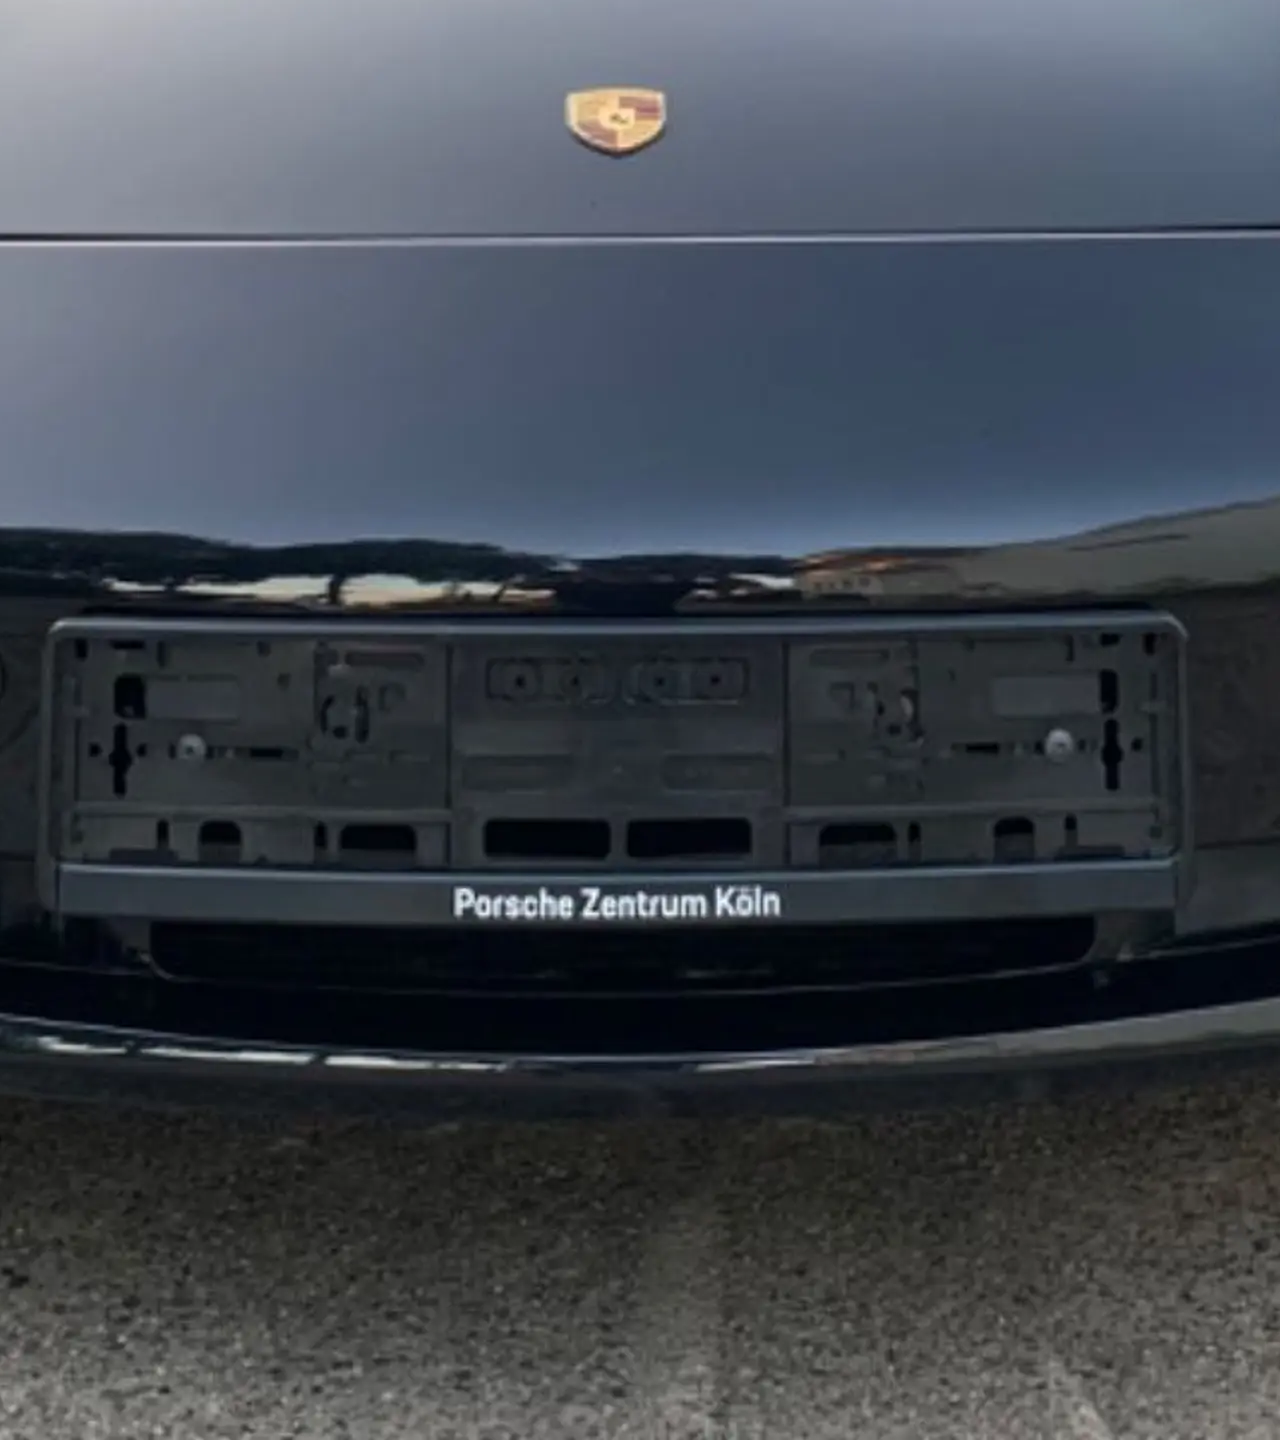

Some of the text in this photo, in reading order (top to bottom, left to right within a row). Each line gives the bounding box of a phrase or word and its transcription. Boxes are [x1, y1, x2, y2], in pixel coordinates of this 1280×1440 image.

[453, 883, 782, 920] Porsche Zentrum Köln
